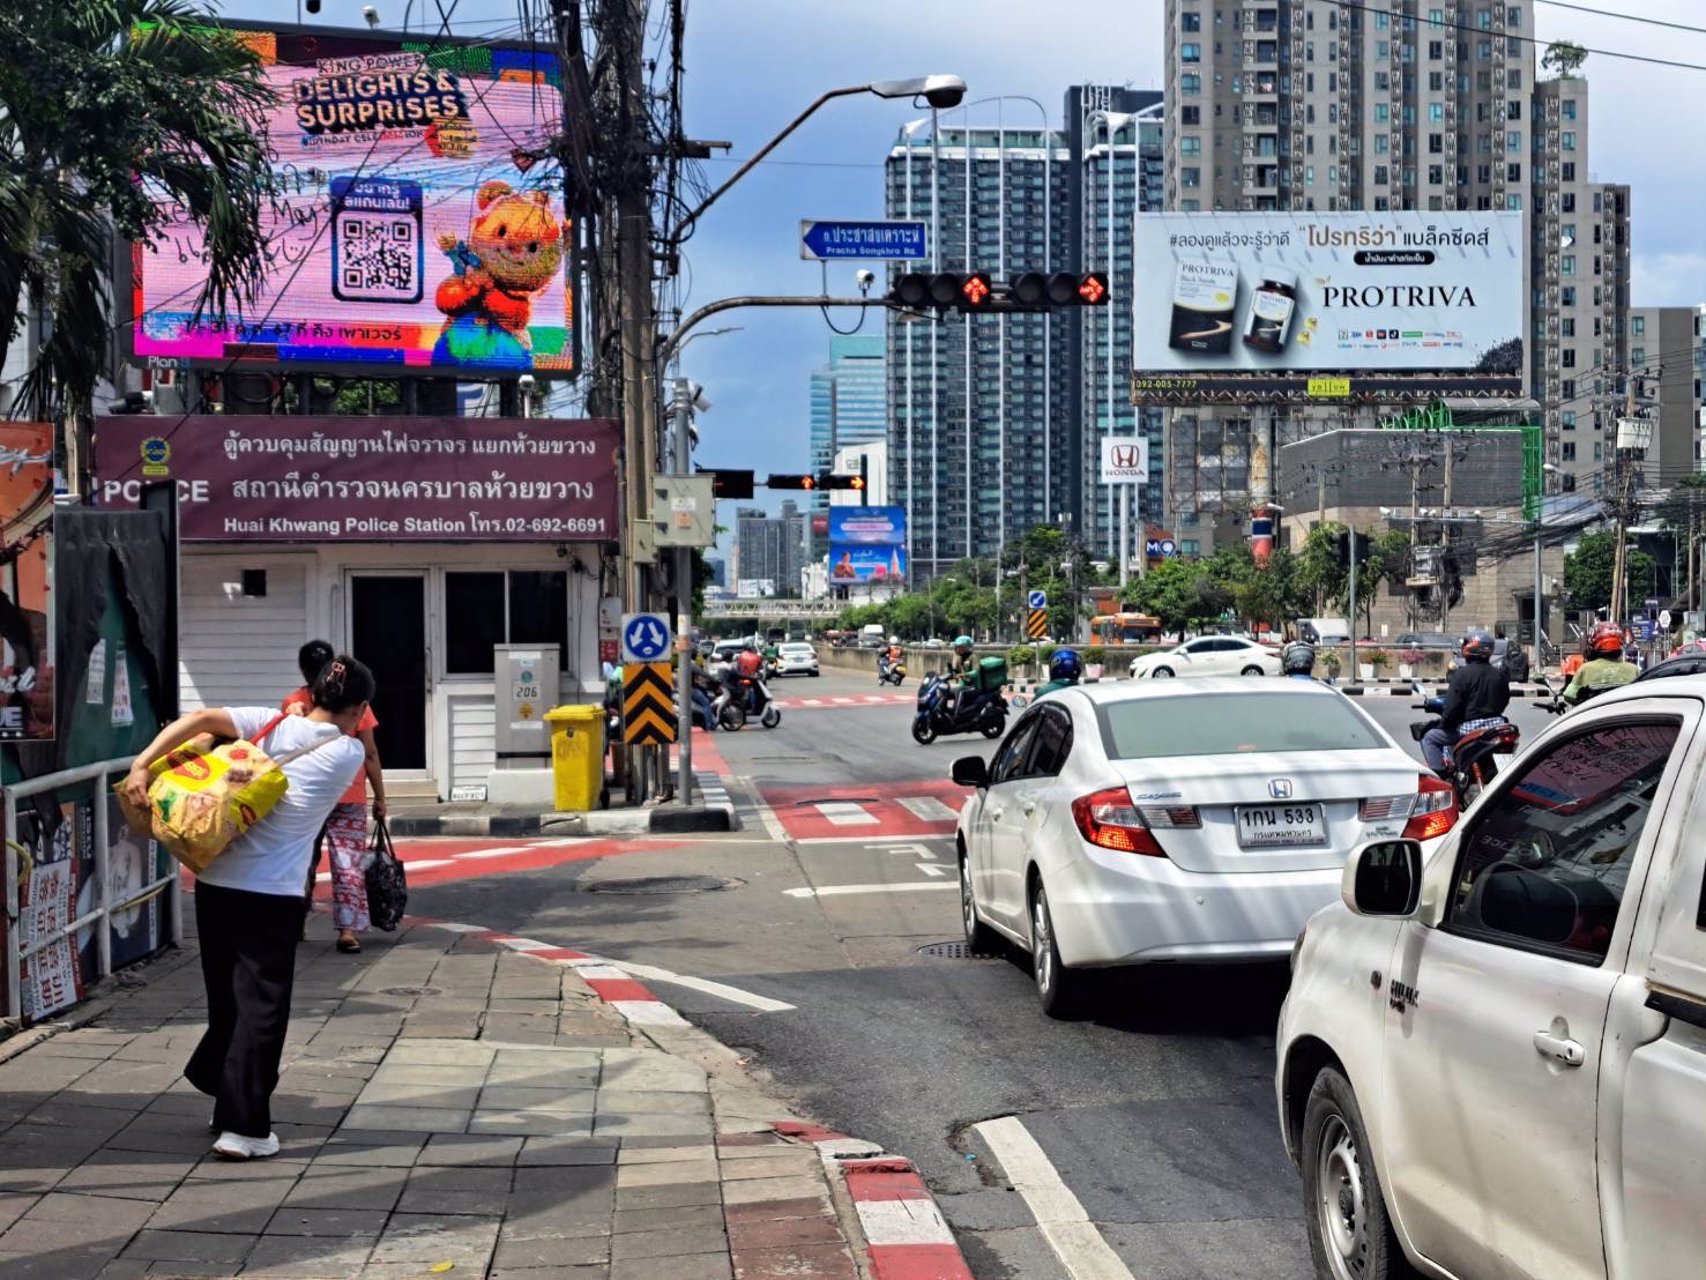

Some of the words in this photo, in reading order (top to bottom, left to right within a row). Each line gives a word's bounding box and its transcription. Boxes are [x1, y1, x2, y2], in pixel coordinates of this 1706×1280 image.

[318, 57, 361, 73] KING
[365, 53, 425, 69] POWER
[294, 72, 431, 100] DELIGHTS
[436, 68, 456, 92] &
[297, 95, 460, 128] SURPRISES
[826, 246, 857, 255] Pracha
[1170, 230, 1290, 251] #ลองดูแล้วจะรู้ว่าดี
[1182, 263, 1234, 278] PROTRIVA
[1322, 286, 1477, 308] PROTRIVA
[338, 324, 403, 341] เพาเวอร์
[148, 355, 188, 368] Plan
[472, 431, 597, 454] แยกห้วยขวาง
[1105, 469, 1145, 477] HONDA
[104, 480, 209, 502] POCE
[232, 470, 594, 499] สถานีตำรวจนครบาลห้วยขวาง
[224, 517, 264, 532] Huai
[268, 517, 340, 536] Khwang
[345, 517, 399, 532] Police
[404, 516, 465, 532] Station
[469, 511, 606, 533] โทร.02-692-6691
[516, 686, 537, 698] 206
[1243, 810, 1276, 827] 1กน
[1284, 808, 1314, 824] 533
